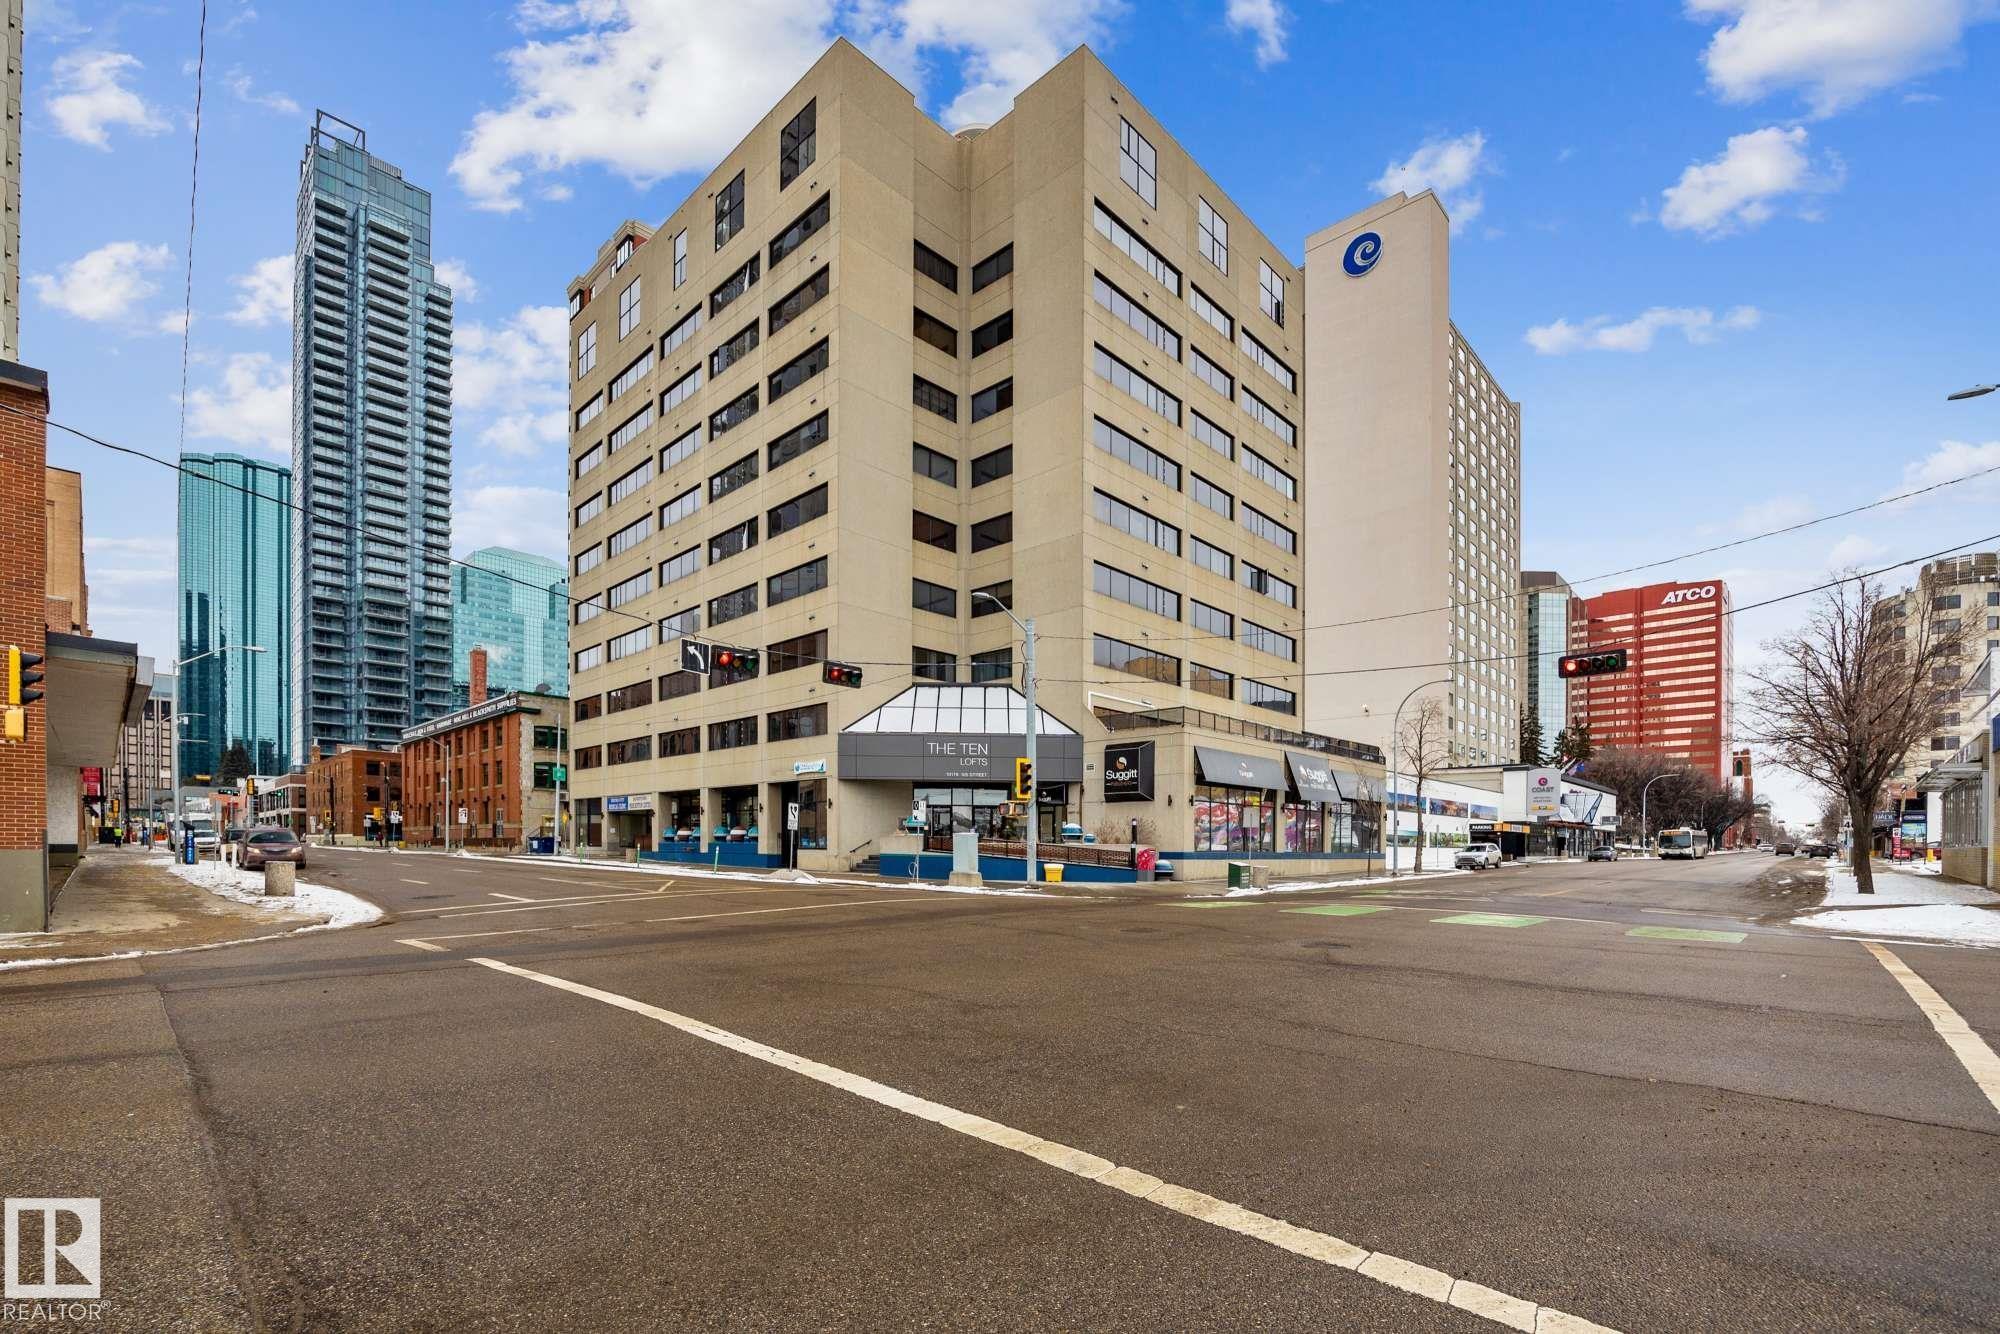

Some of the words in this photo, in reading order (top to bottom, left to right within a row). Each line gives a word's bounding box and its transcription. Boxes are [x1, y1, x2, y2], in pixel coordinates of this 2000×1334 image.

[1661, 585, 1716, 605] ATCO
[497, 697, 517, 710] SUPPLIES
[926, 742, 956, 755] THE
[960, 742, 988, 755] TEN
[960, 757, 988, 767] LOFTS
[1106, 769, 1137, 781] Suggitt
